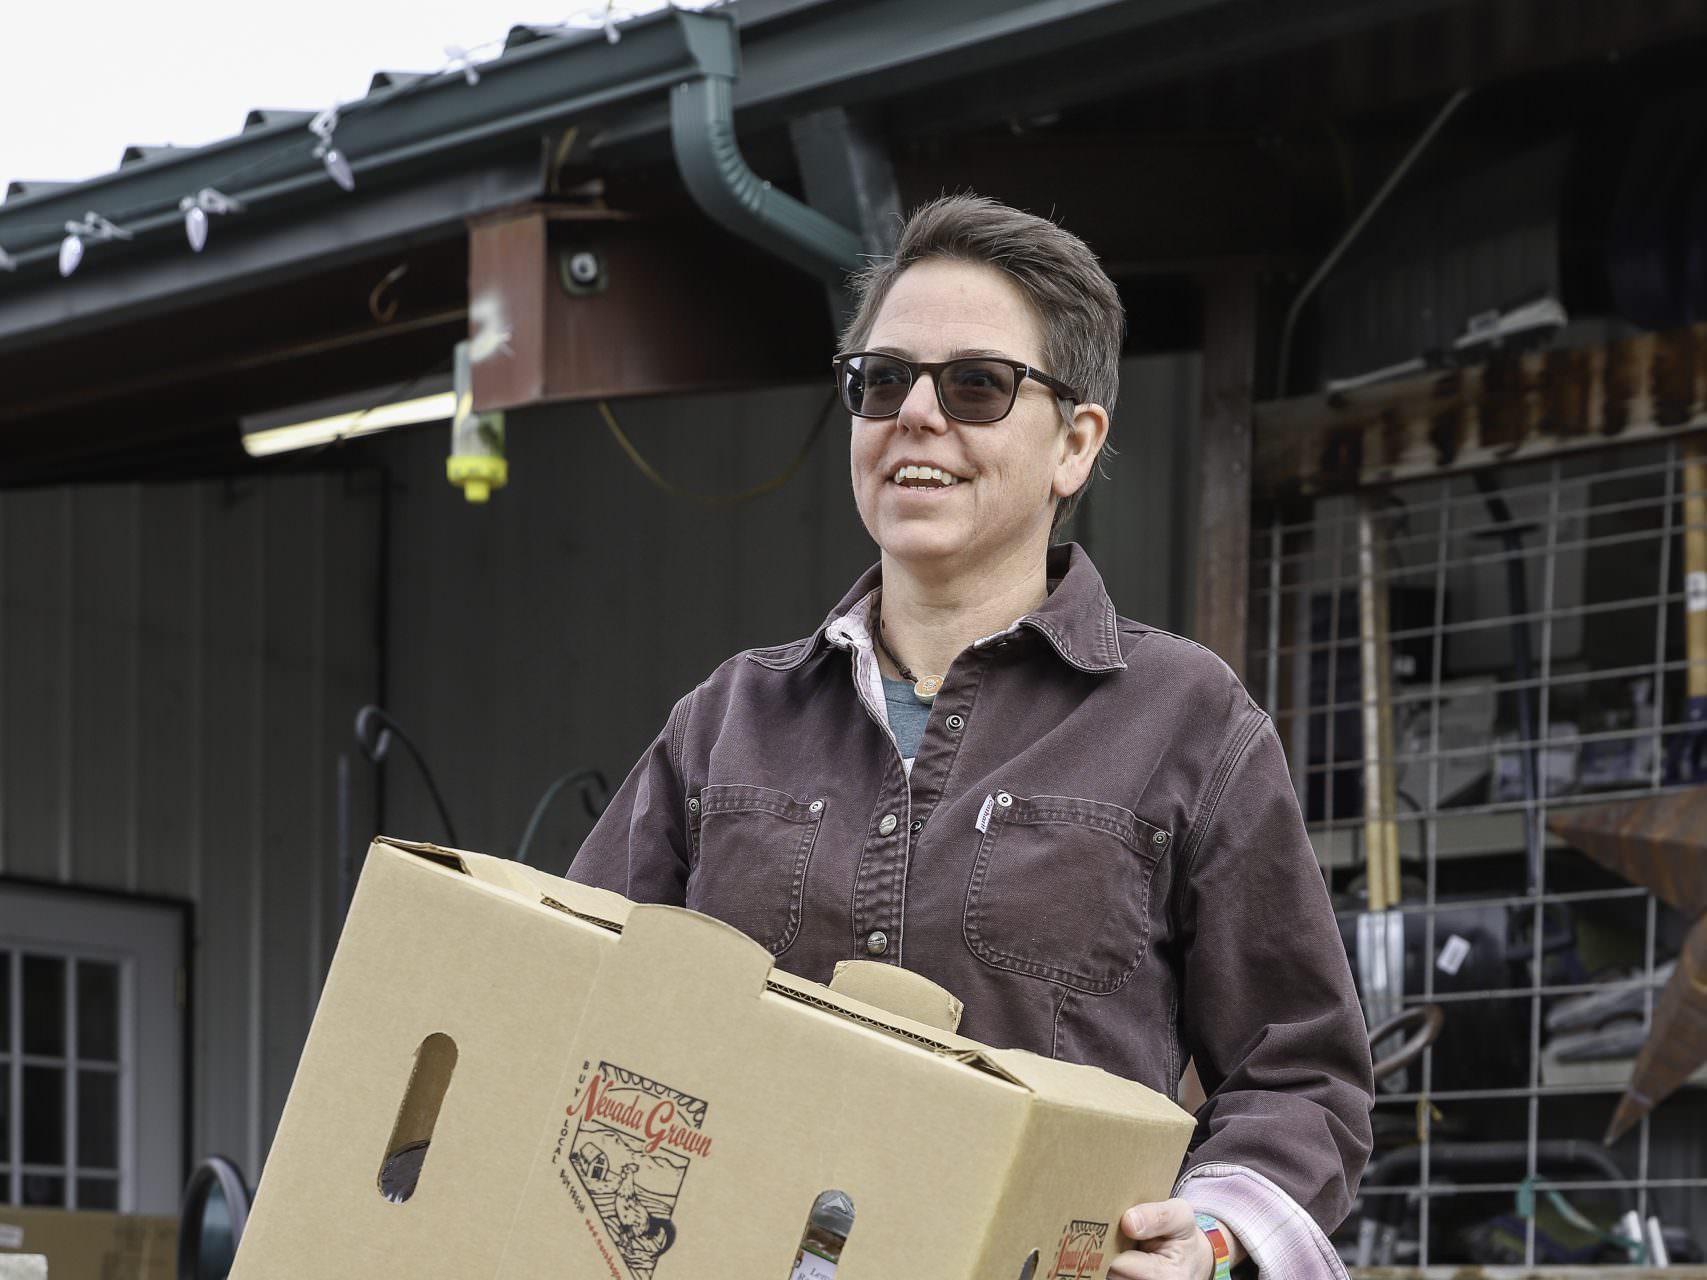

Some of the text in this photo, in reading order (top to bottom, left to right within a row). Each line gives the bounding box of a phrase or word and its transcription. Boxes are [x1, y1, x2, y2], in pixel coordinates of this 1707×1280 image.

[552, 1061, 590, 1164] BUY LOCAL
[566, 1074, 712, 1157] Nevada Grown
